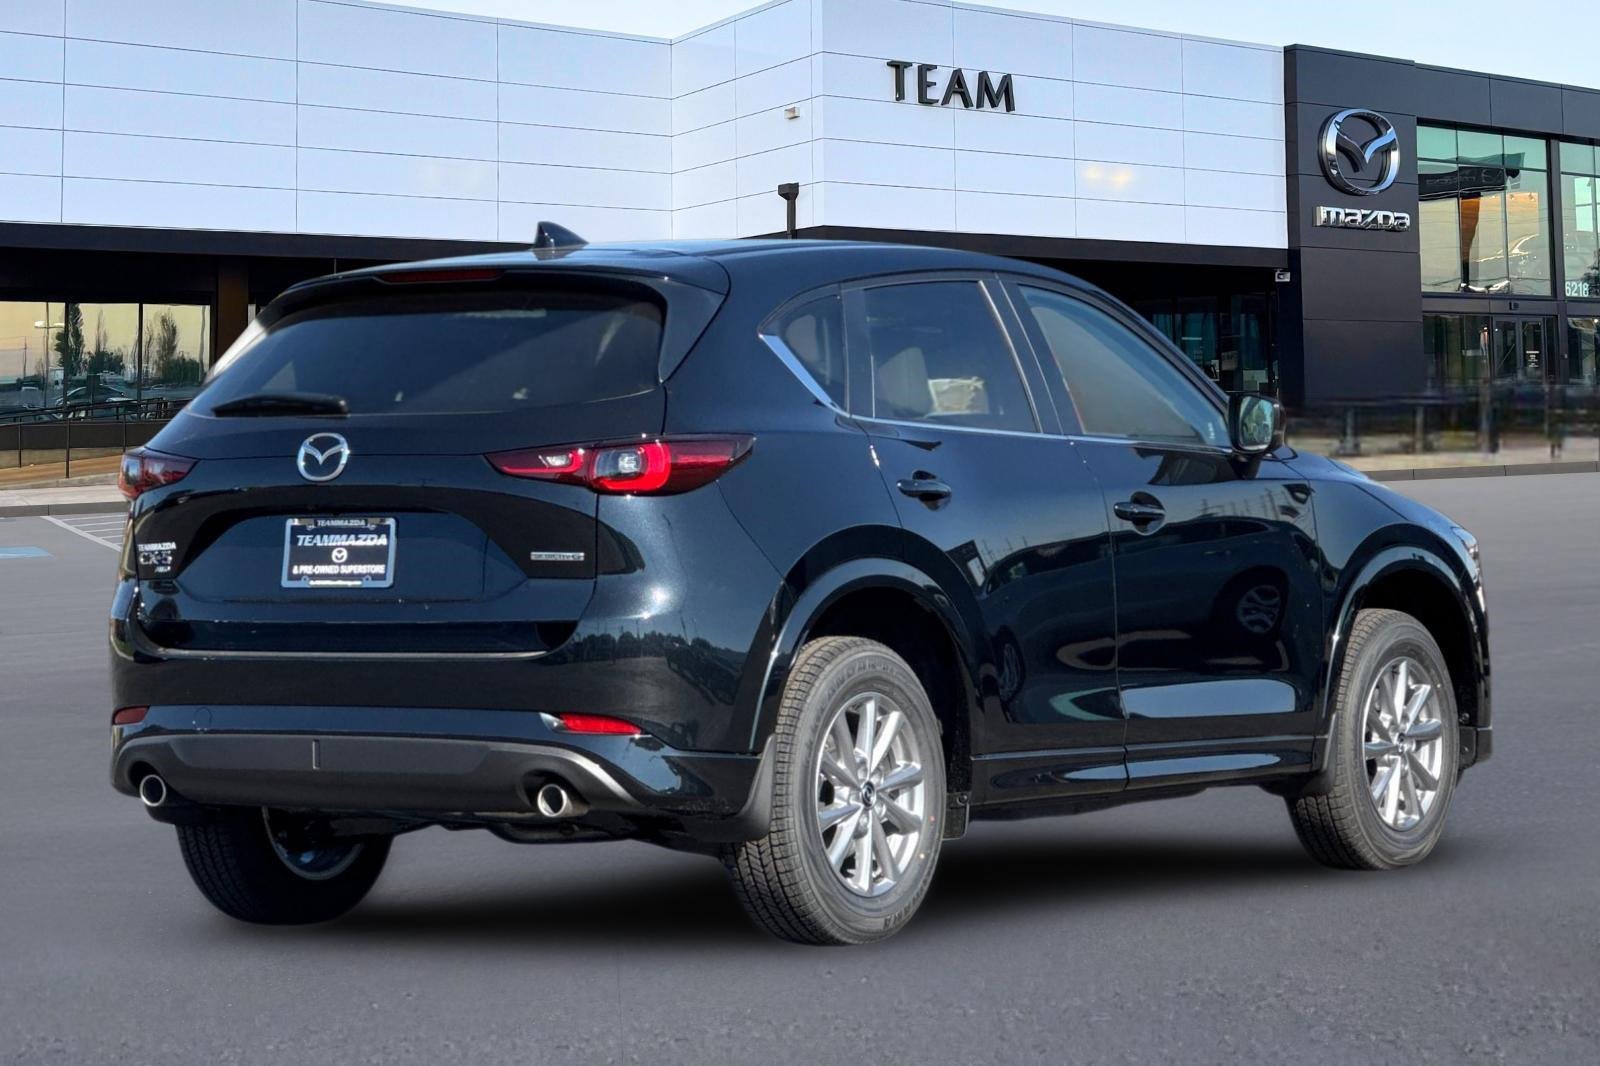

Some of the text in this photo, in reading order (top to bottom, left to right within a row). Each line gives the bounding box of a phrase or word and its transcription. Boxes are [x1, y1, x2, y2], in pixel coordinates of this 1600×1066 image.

[886, 60, 1015, 112] TEAM
[1565, 281, 1589, 297] 6218
[296, 534, 388, 546] TEAMMAZDA
[299, 565, 339, 575] PRE-OWNED
[340, 564, 386, 574] SUPERSTORE
